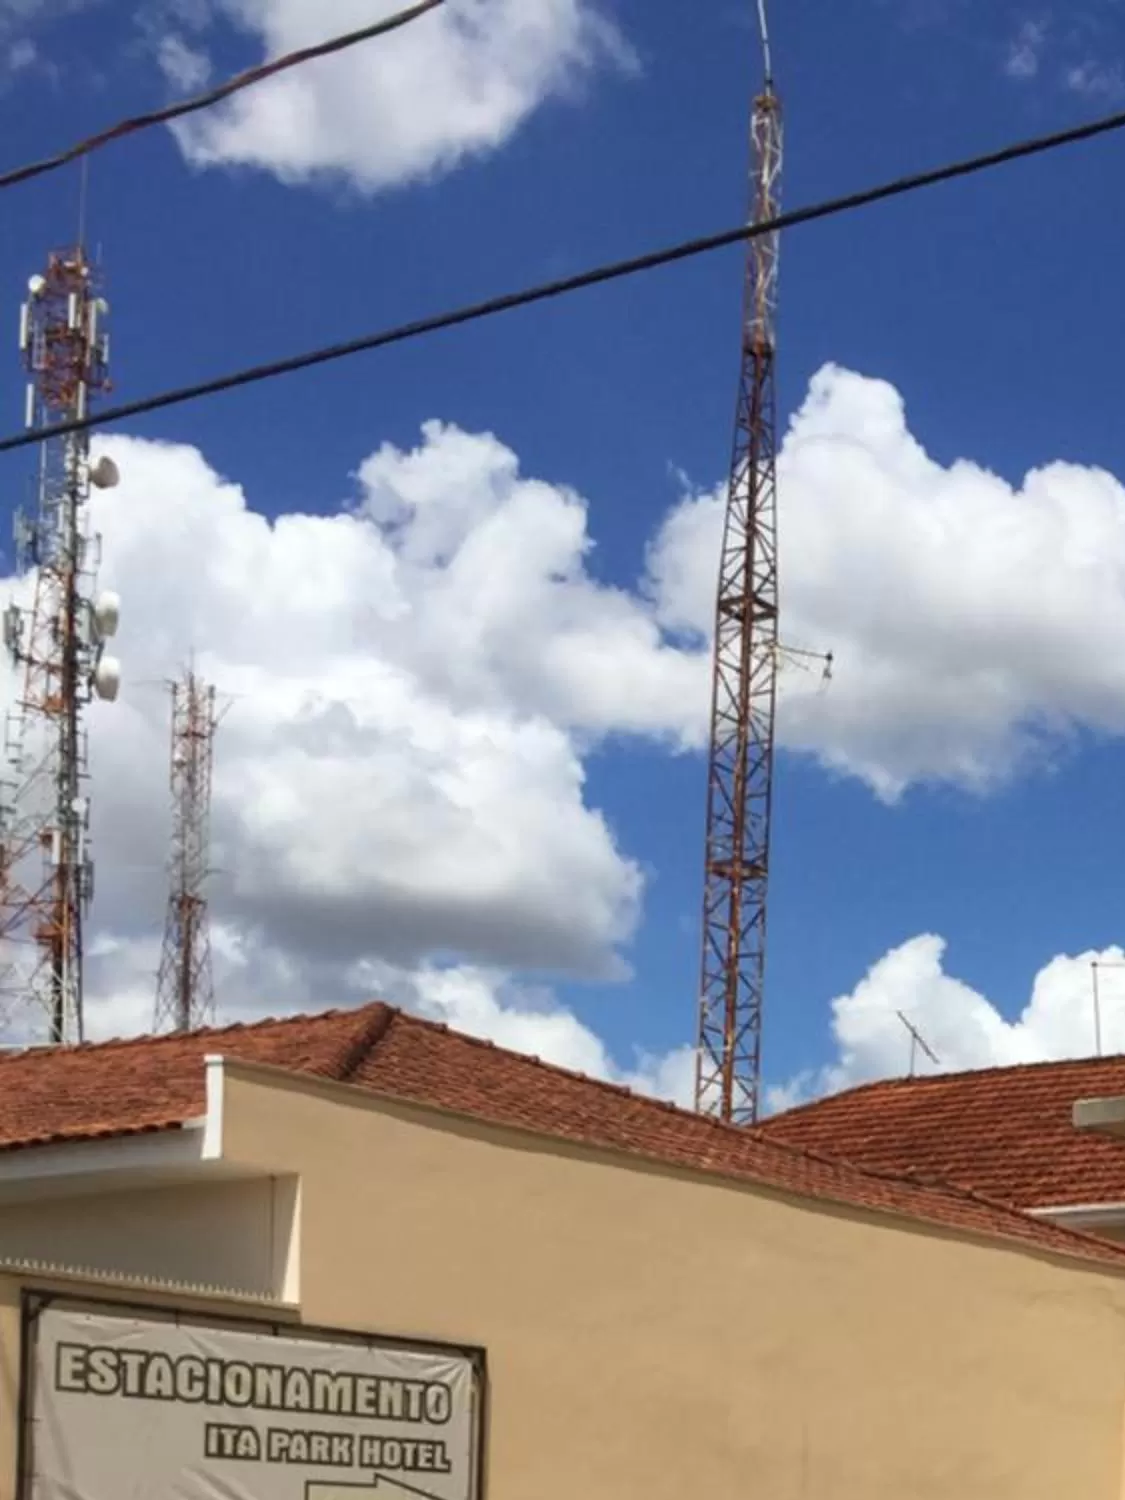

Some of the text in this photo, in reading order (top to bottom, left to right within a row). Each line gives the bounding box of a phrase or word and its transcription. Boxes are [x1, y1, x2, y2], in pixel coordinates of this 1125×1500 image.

[56, 1341, 452, 1424] ESTACIONAMENTO
[205, 1422, 452, 1473] ITA PARK HOTEL
